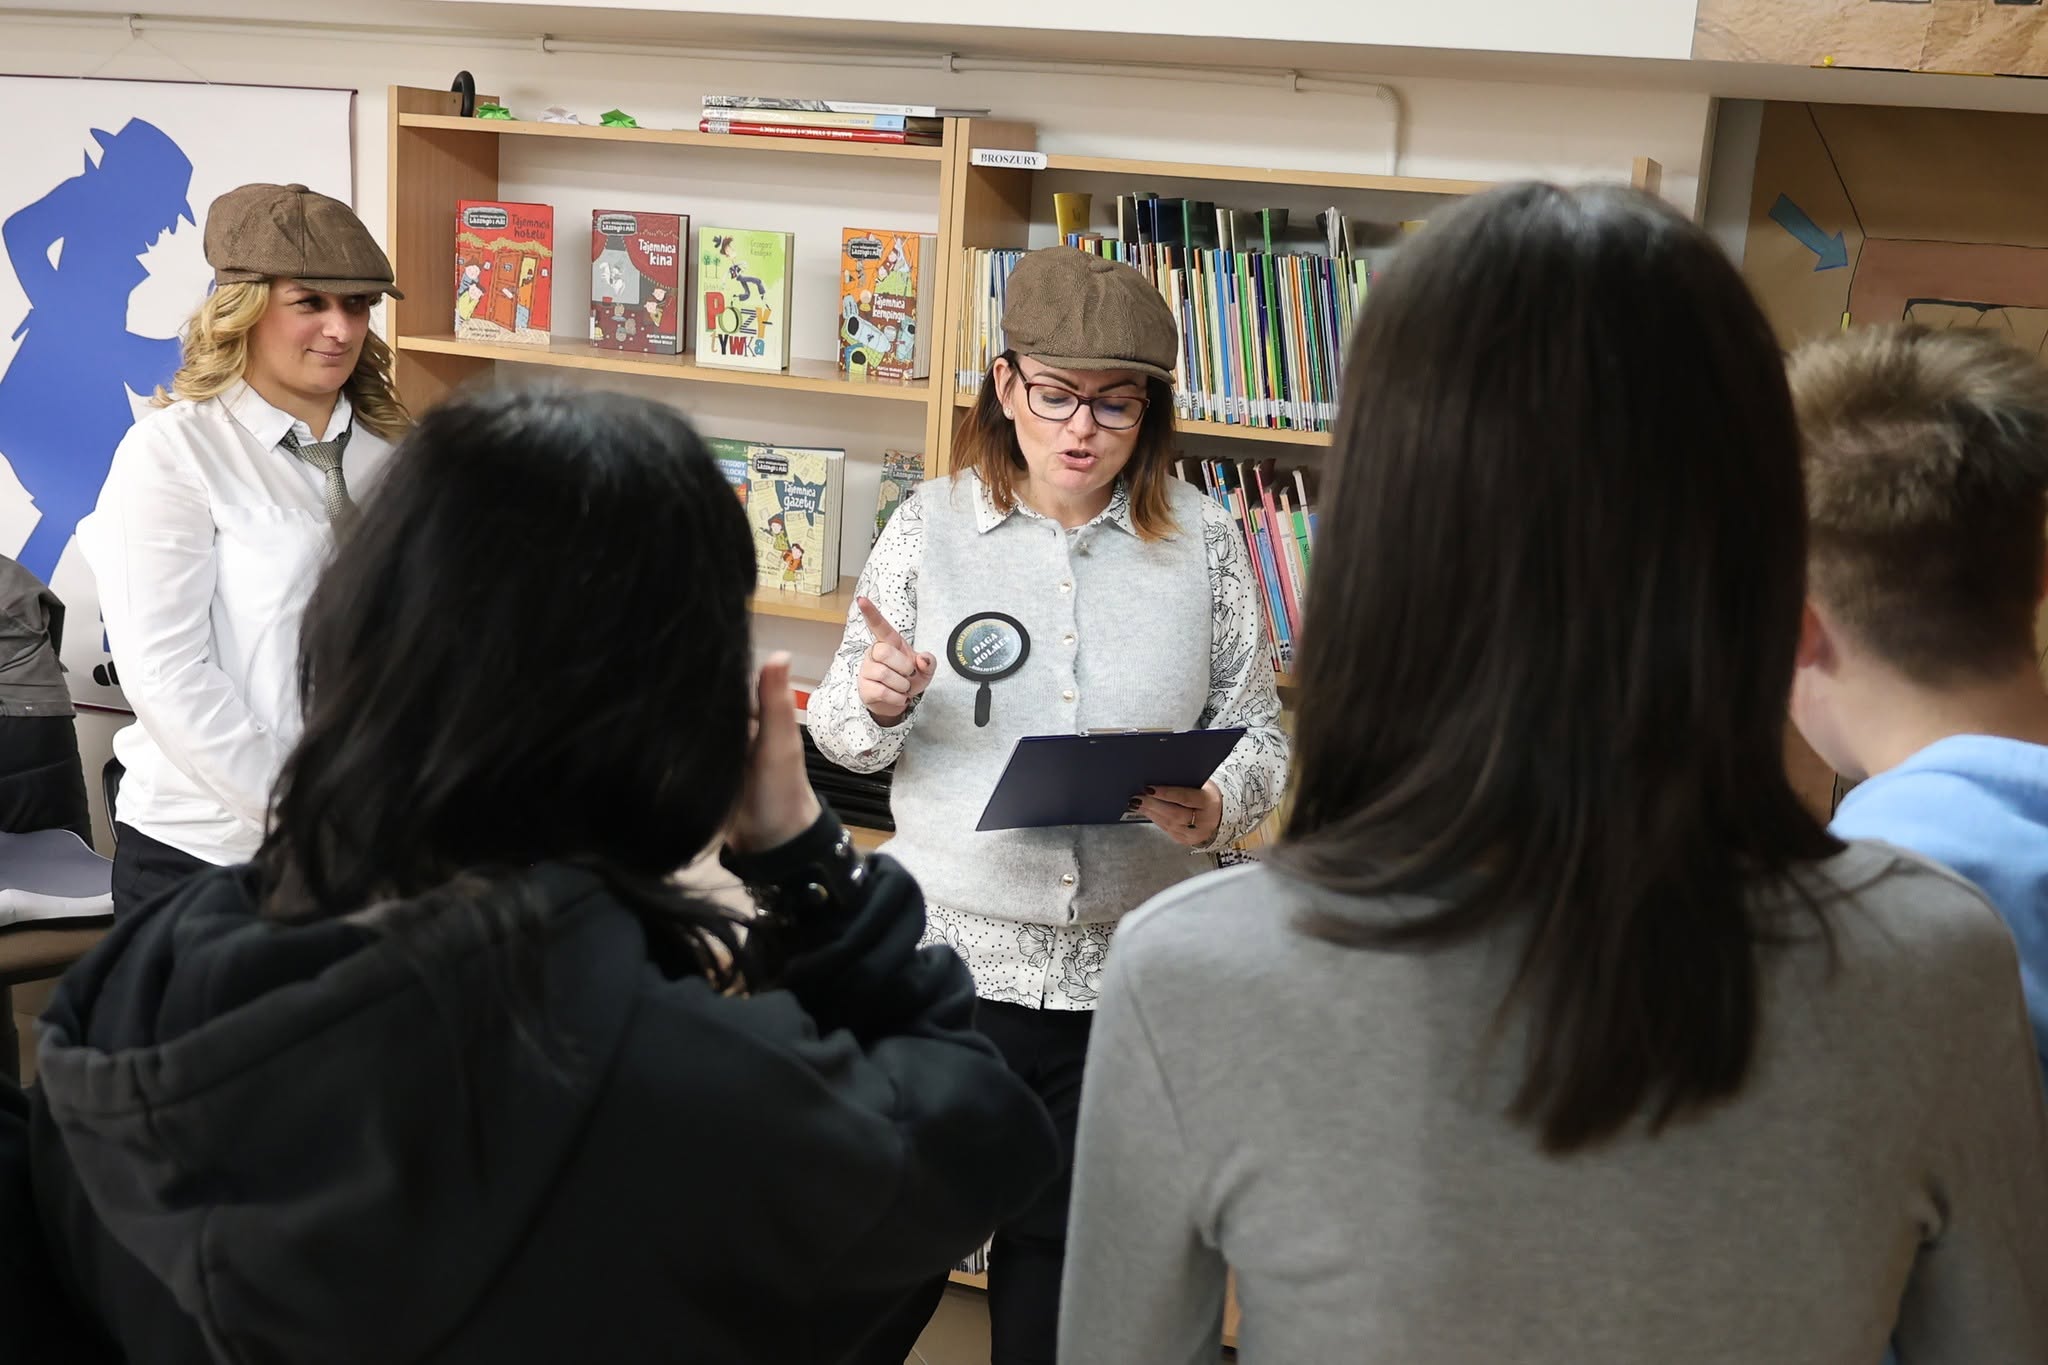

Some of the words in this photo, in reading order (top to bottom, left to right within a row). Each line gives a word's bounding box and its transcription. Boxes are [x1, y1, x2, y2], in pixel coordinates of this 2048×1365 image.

[980, 153, 1039, 166] BROSZURY
[512, 214, 550, 229] Tajemnica
[514, 227, 546, 240] hotelu
[638, 238, 677, 255] Tajemnica
[649, 252, 673, 266] kina
[873, 294, 906, 309] Tajemnica
[872, 308, 906, 323] kempingu
[783, 481, 816, 497] Tajemnica
[784, 495, 816, 513] gazety
[972, 632, 998, 655] DAGA
[973, 636, 1010, 666] HOLMES
